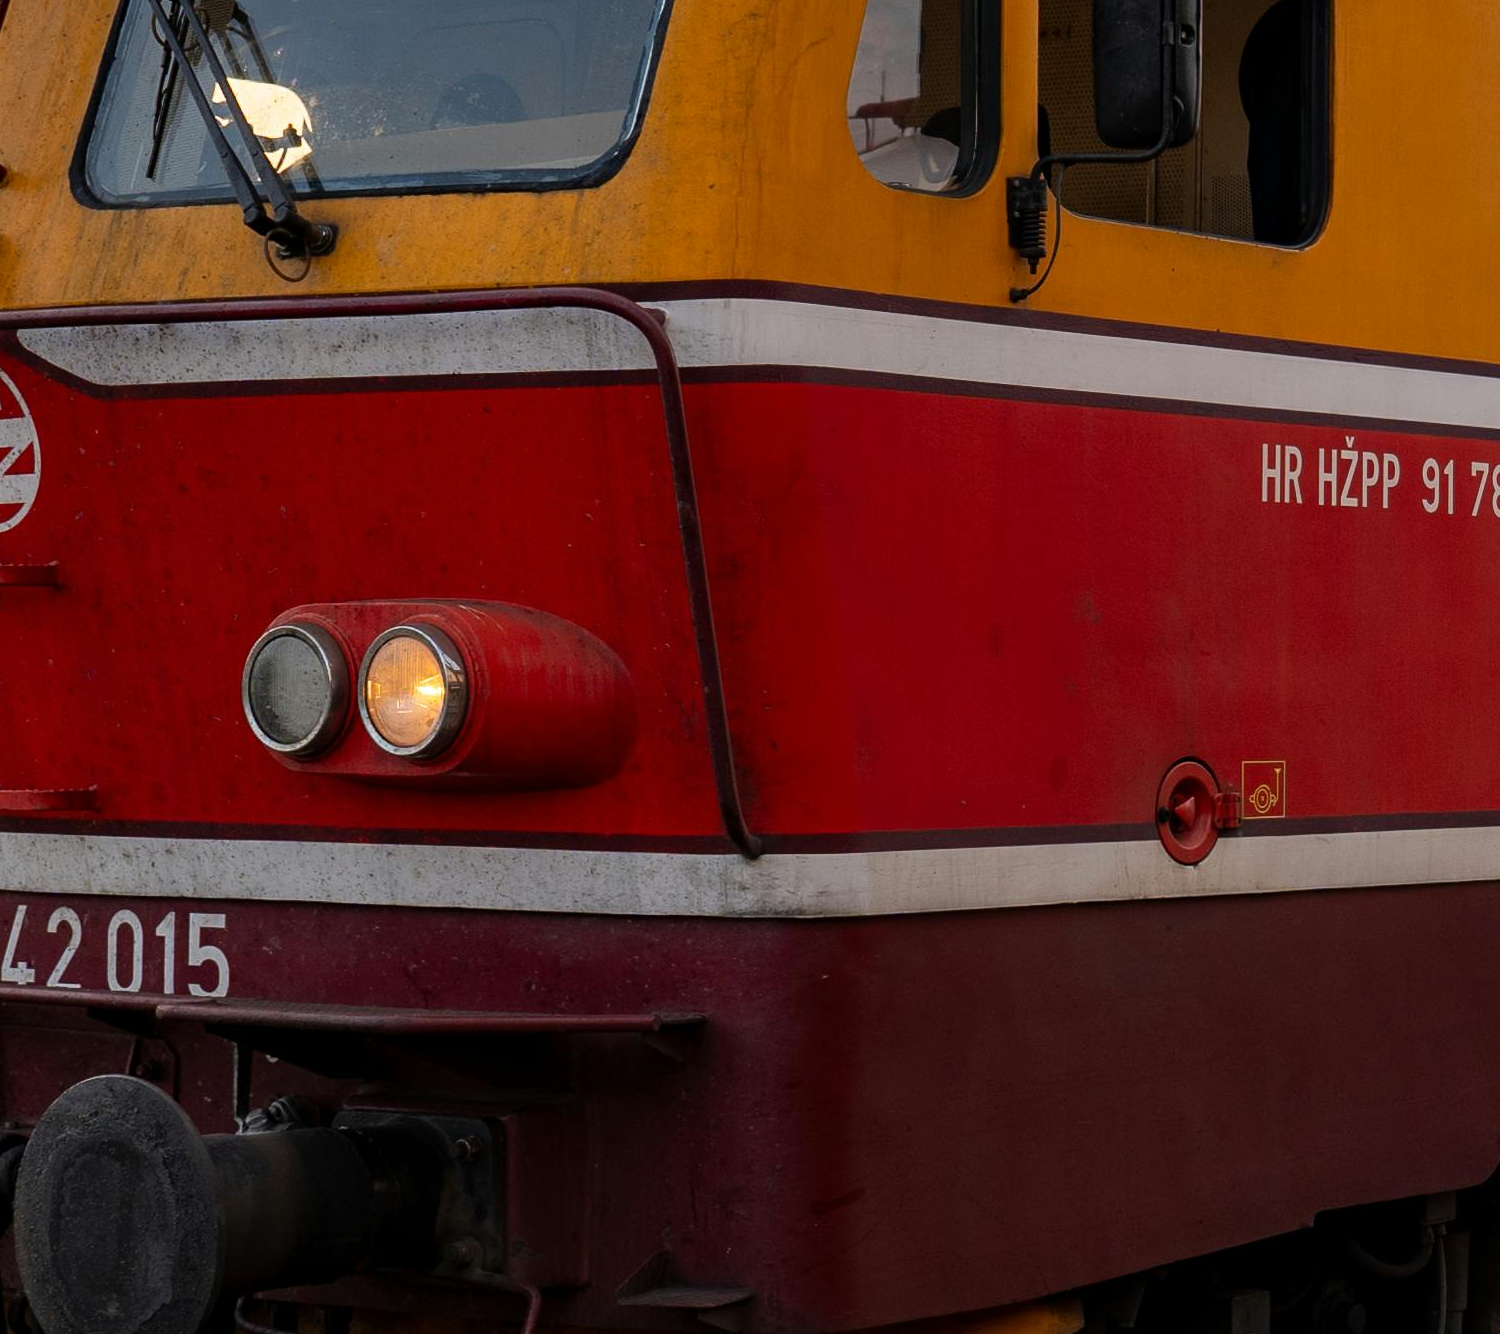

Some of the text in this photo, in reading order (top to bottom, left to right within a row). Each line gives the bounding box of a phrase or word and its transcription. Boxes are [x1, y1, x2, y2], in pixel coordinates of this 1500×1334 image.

[1261, 443, 1302, 504] HR
[1318, 436, 1400, 509] HŽPP
[1422, 457, 1454, 515] 91
[107, 909, 230, 998] 015
